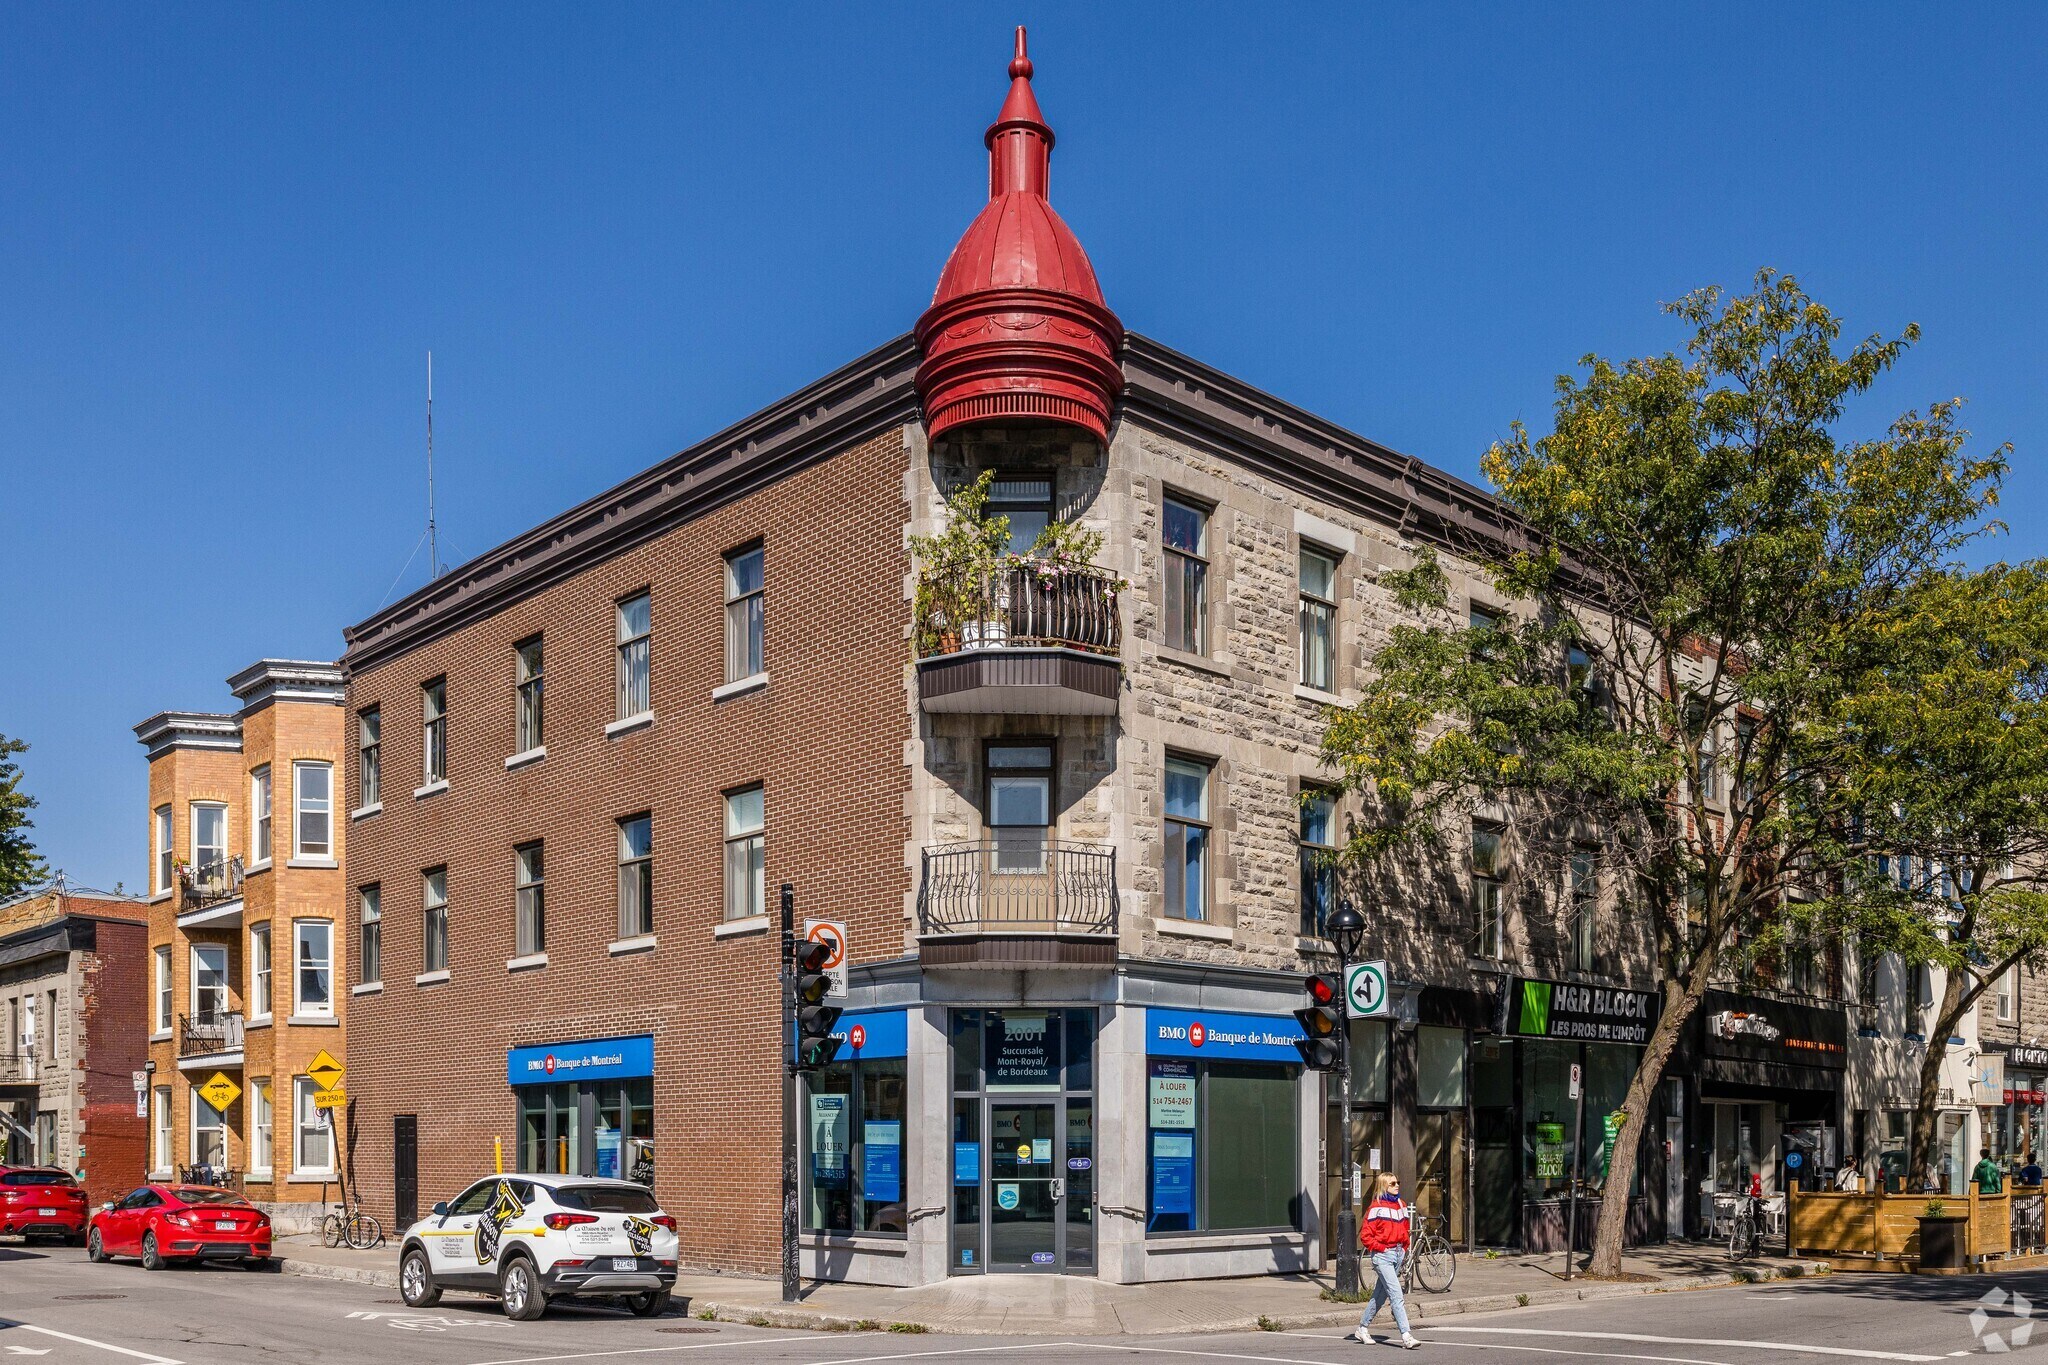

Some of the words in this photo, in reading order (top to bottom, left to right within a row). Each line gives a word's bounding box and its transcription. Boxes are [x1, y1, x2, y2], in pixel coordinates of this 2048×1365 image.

[1554, 985, 1590, 1013] H&R
[1593, 991, 1648, 1018] BLOCK
[1004, 1027, 1042, 1041] 2001
[1551, 1020, 1569, 1036] LES
[1571, 1021, 1597, 1038] PROS
[1599, 1024, 1611, 1039] DE
[1158, 1026, 1186, 1039] BMO
[1208, 1029, 1246, 1045] Banque
[1248, 1032, 1260, 1043] de
[1002, 1046, 1044, 1055] Succursale
[528, 1059, 544, 1071] BMO
[556, 1058, 581, 1070] Banque
[582, 1056, 590, 1066] de
[592, 1053, 622, 1066] Montréal
[997, 1056, 1049, 1067] Mont-Royal/
[997, 1067, 1008, 1076] de
[1010, 1067, 1048, 1076] Bordeaux
[1166, 1082, 1187, 1091] LOUER
[328, 1094, 338, 1102] 250
[1152, 1097, 1163, 1105] 514
[1164, 1096, 1193, 1106] 754-2467
[997, 1120, 1012, 1128] BMO
[1069, 1119, 1086, 1127] BMO
[816, 1142, 844, 1151] LOUER
[1537, 1163, 1563, 1176] BLOCK
